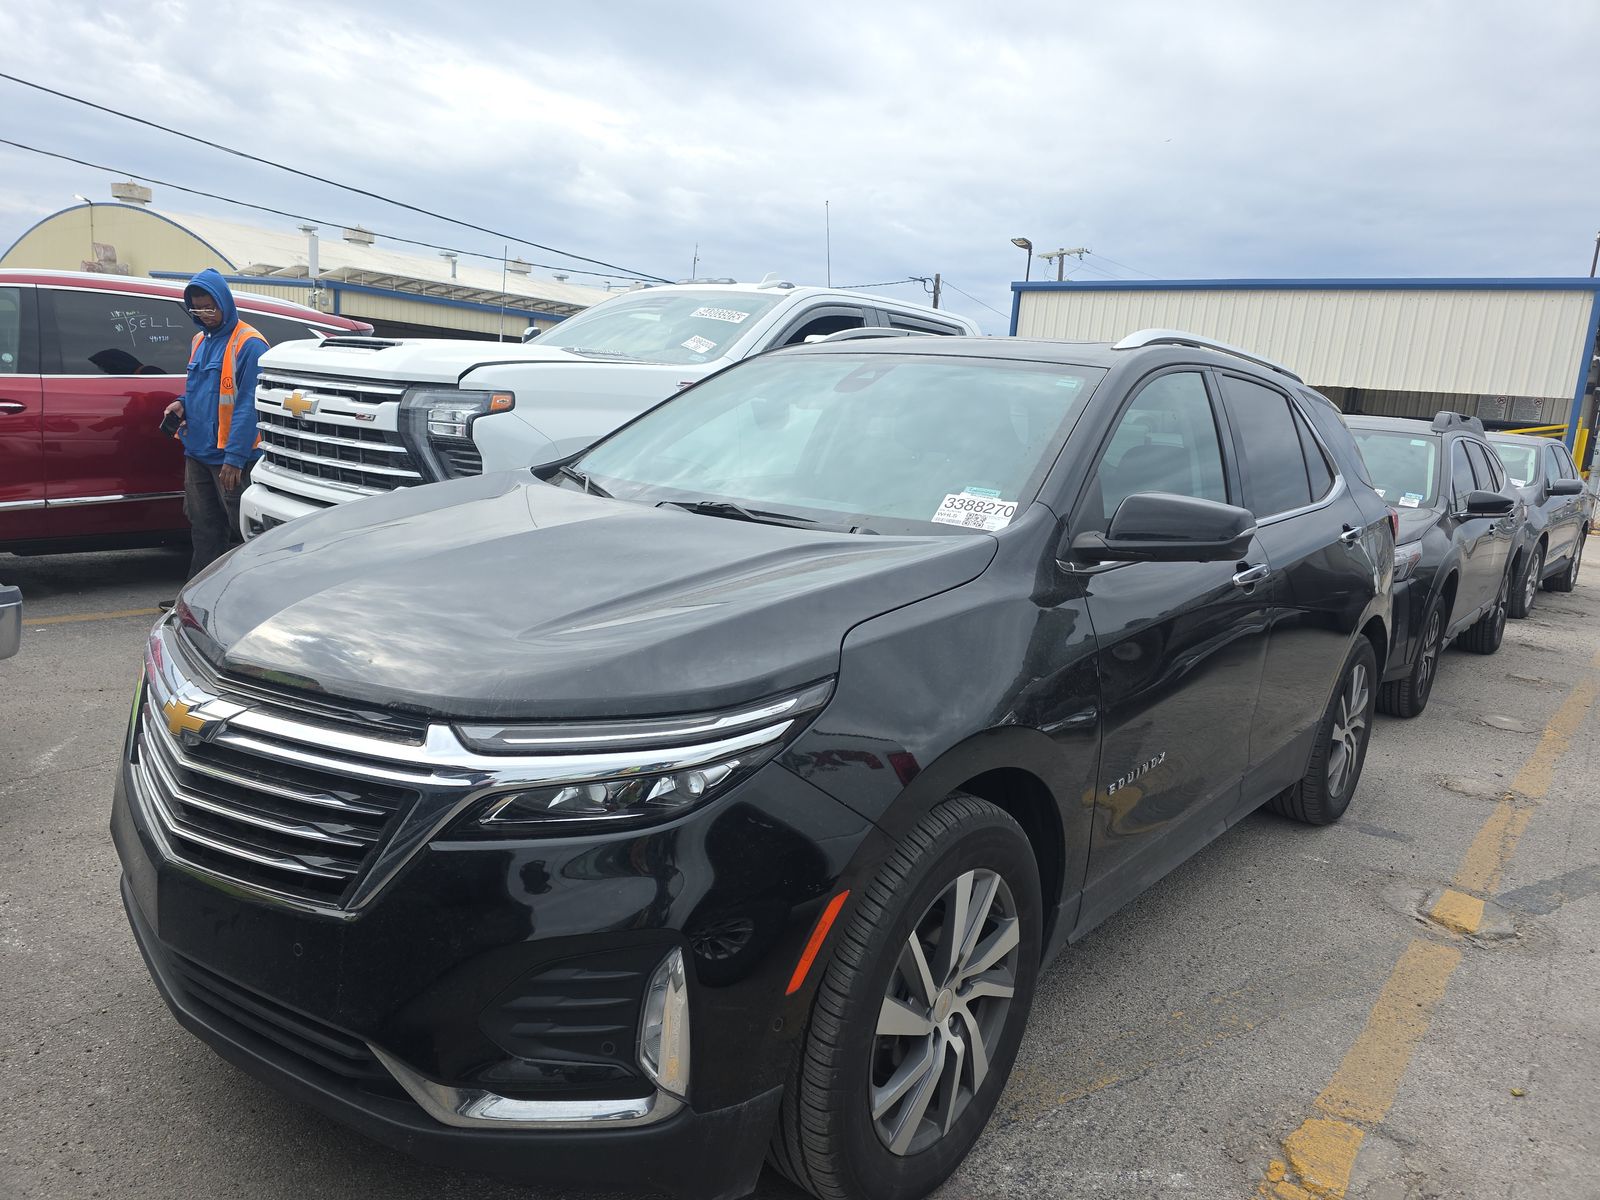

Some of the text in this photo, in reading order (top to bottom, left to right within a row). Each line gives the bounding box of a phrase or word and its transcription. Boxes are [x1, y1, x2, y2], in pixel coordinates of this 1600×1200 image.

[128, 317, 184, 333] SELL
[944, 497, 1015, 518] 3388270
[1109, 751, 1166, 796] EQUINOX
